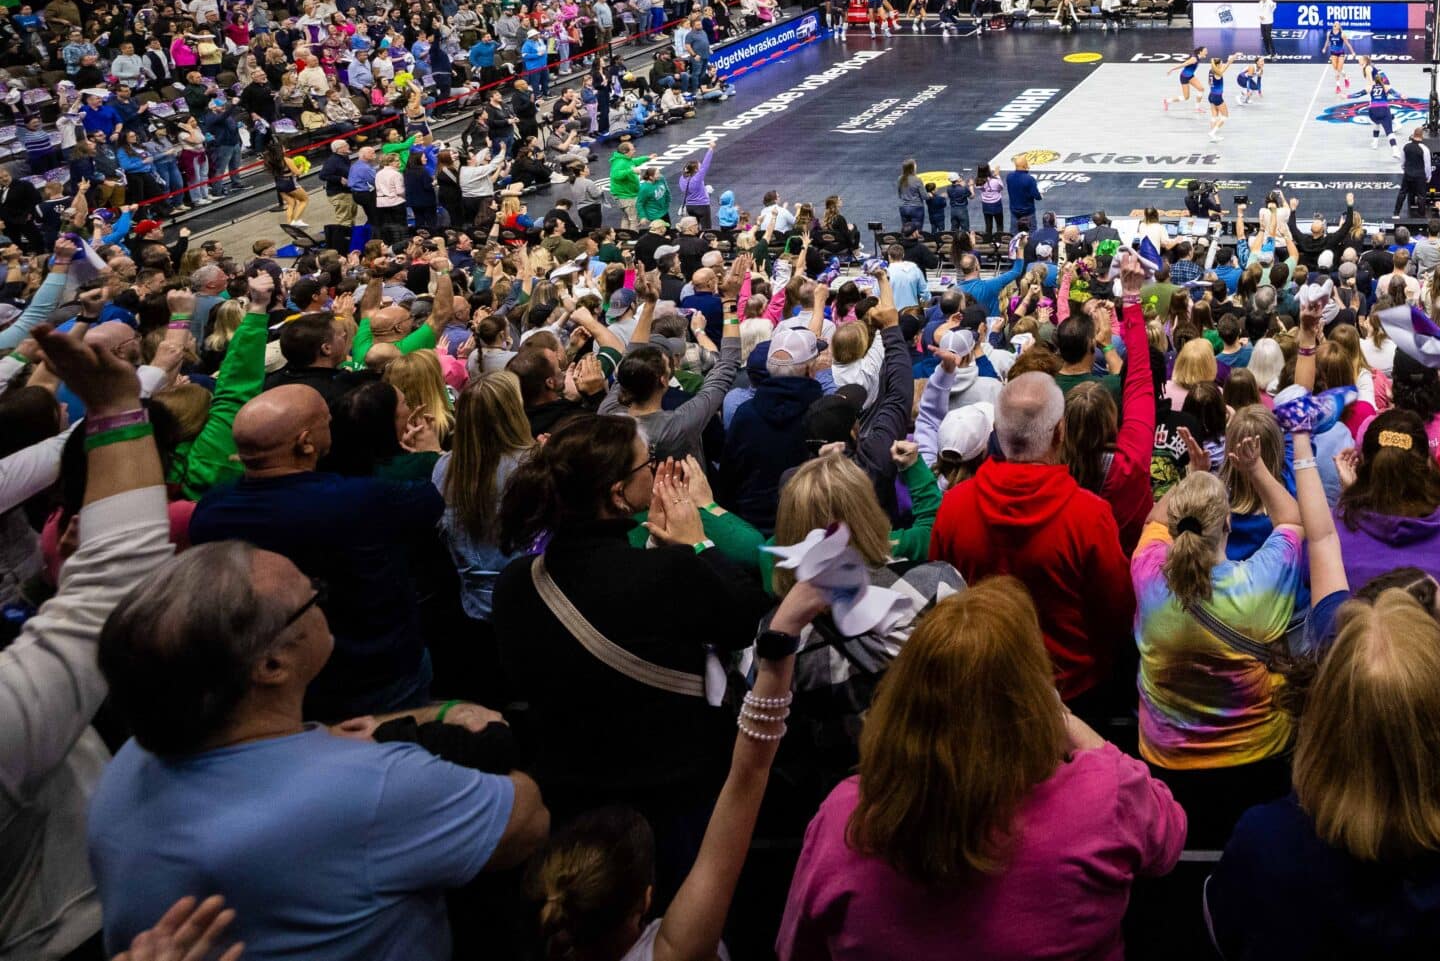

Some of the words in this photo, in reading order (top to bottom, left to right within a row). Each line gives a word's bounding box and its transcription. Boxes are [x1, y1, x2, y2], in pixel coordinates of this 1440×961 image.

[1326, 5, 1371, 20] PROTEIN
[707, 28, 796, 71] udgetNebraska.com
[1372, 88, 1383, 96] 27
[637, 130, 727, 170] major
[715, 89, 805, 130] league
[797, 50, 888, 92] volleyball
[865, 110, 908, 129] Spine
[895, 85, 948, 110] Hospital
[976, 88, 1061, 132] OMAHA
[1062, 152, 1221, 166] Kiewit
[1028, 171, 1092, 183] airlife
[1137, 178, 1196, 189] E15
